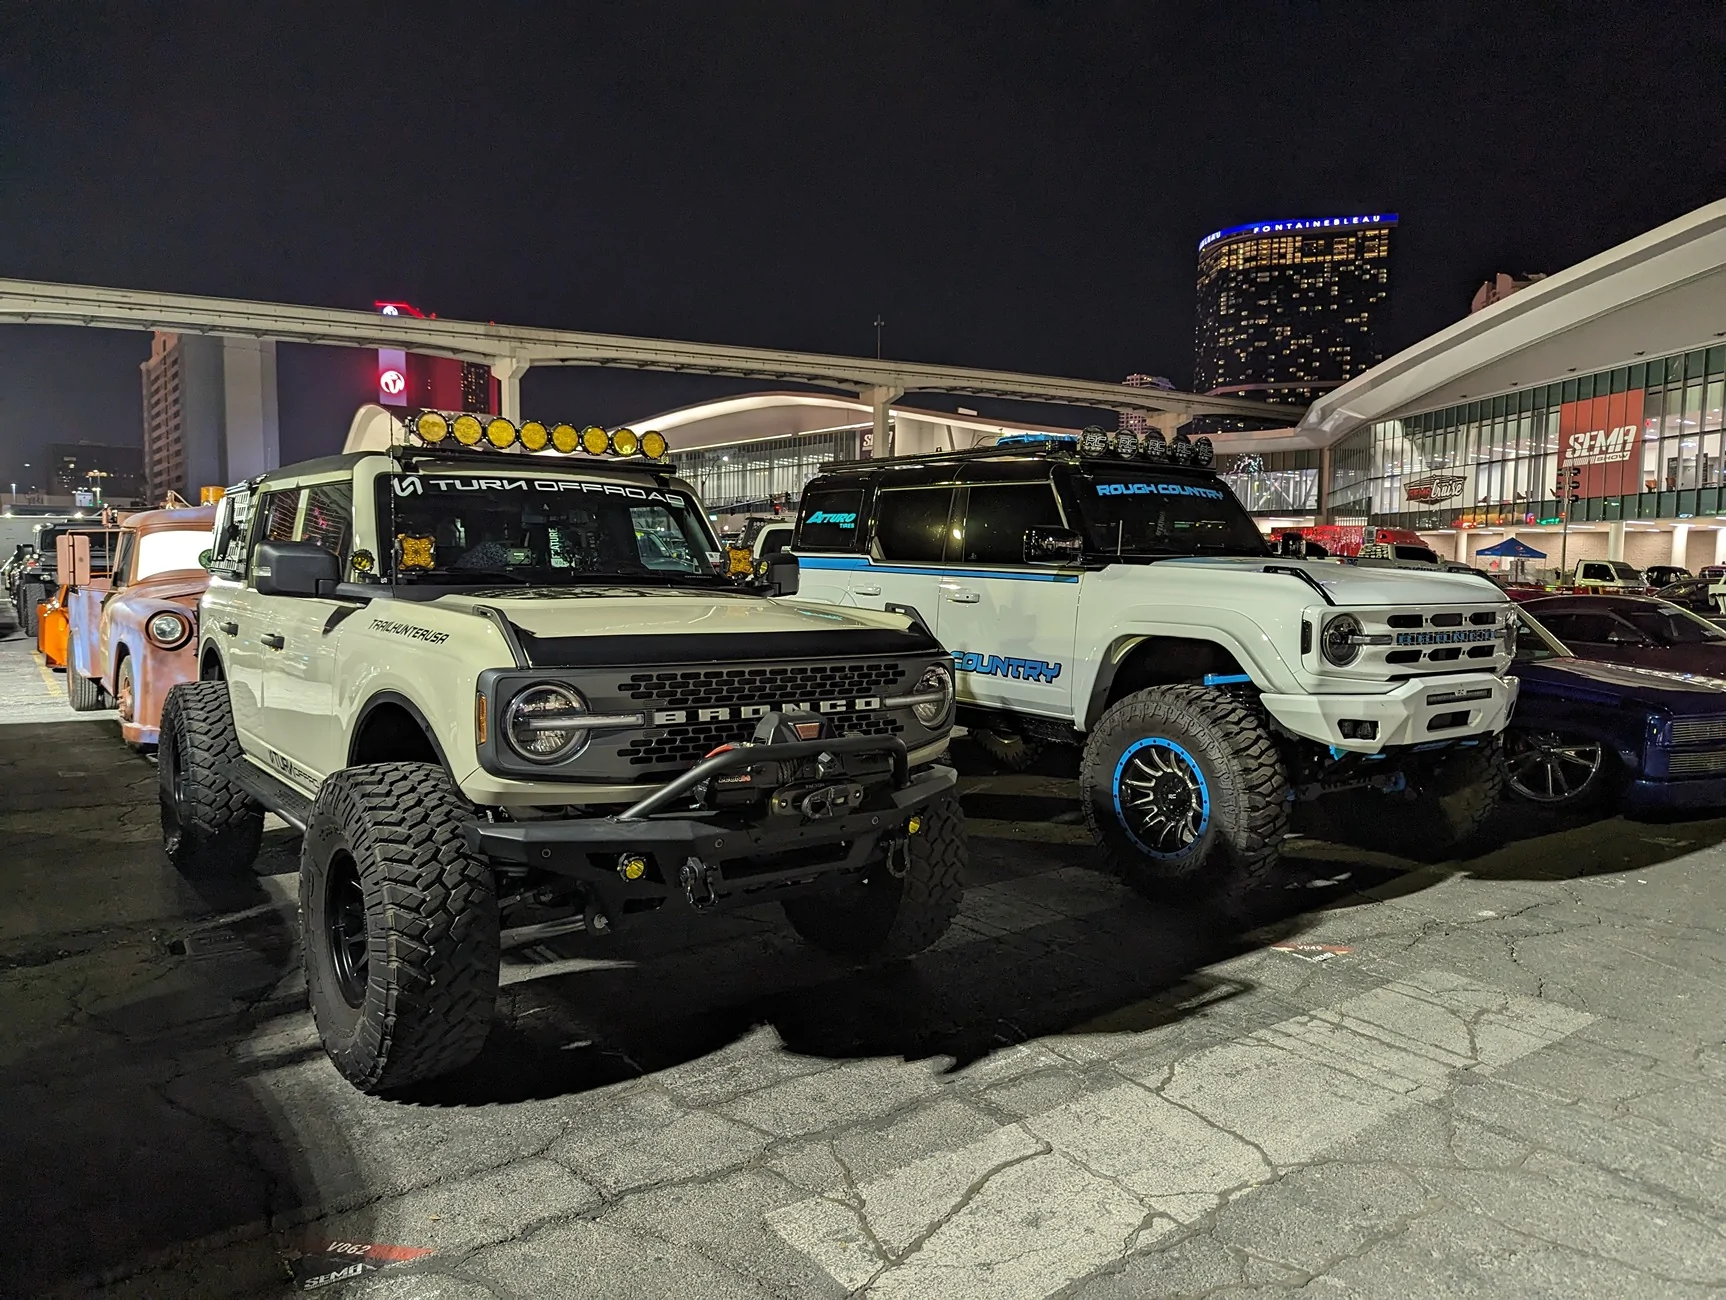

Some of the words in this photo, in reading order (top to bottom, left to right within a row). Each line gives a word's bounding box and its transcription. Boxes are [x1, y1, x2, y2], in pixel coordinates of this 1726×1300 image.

[1253, 215, 1380, 233] FONTAINEBLEAU
[1565, 425, 1637, 458] SEMA
[429, 479, 527, 491] TURN
[534, 481, 686, 506] OFFROAD
[1096, 483, 1157, 496] ROUGH
[1158, 484, 1224, 500] COUNTRY
[1431, 479, 1463, 498] Cruise
[368, 619, 450, 645] TRAILHUNTERUSA
[950, 650, 1062, 684] COUNTRY
[654, 697, 881, 725] BRONCO
[326, 1241, 371, 1255] V062
[304, 1262, 363, 1290] SEMA
